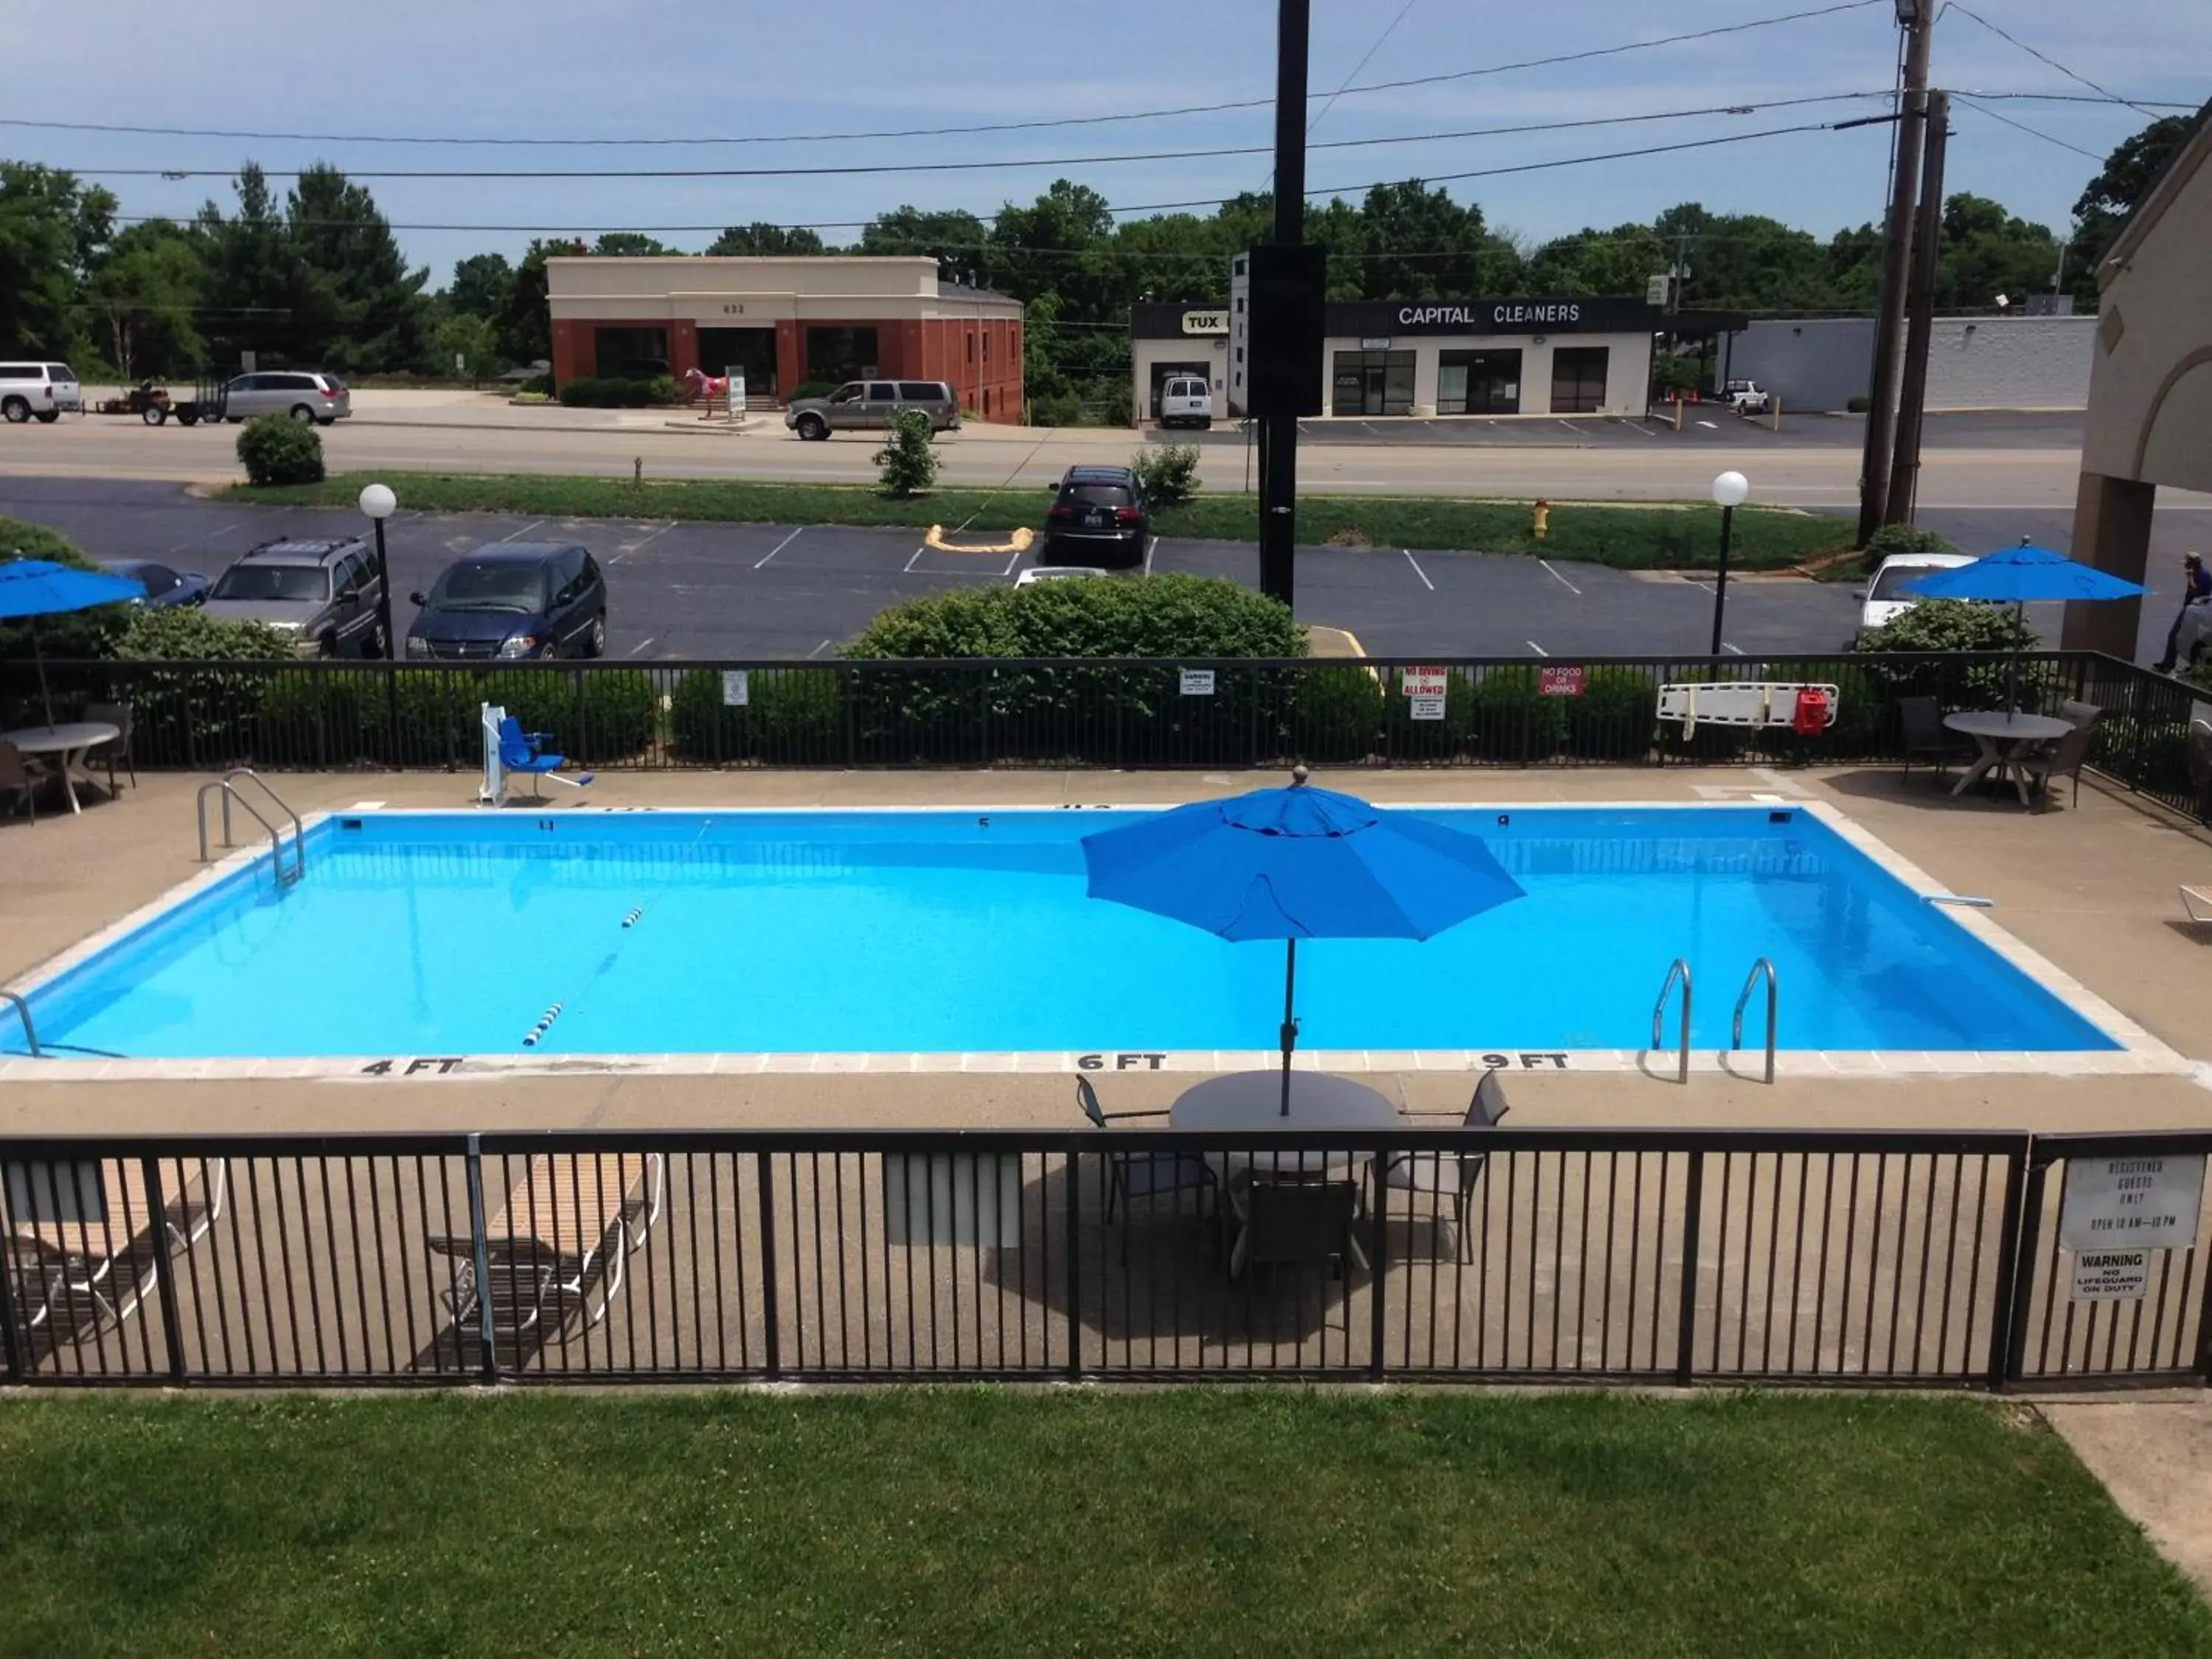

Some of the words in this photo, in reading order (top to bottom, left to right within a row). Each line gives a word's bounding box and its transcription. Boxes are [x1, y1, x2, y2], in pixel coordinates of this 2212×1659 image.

[1399, 307, 1475, 324] CAPITAL
[1494, 305, 1579, 322] CLEANERS
[1188, 316, 1219, 328] TUX
[1405, 666, 1416, 676] NO
[1419, 666, 1446, 676] DIVING
[1542, 667, 1555, 676] NO
[1557, 667, 1582, 676] FOOD
[1404, 685, 1444, 695] ALLOWED
[1545, 684, 1576, 694] DRINKS
[361, 1060, 392, 1076] 4
[403, 1058, 463, 1076] FT
[1078, 1054, 1104, 1070] 6
[1117, 1054, 1166, 1070] FT
[1481, 1054, 1509, 1068] 9
[1520, 1054, 1568, 1068] FT
[2118, 1176, 2152, 1190] GUESTS
[2120, 1192, 2144, 1205] ONLY
[2091, 1218, 2112, 1231] OPEN
[2163, 1215, 2176, 1227] PM
[2081, 1253, 2142, 1267] WARNING
[2078, 1276, 2143, 1284] LIFEGUARD
